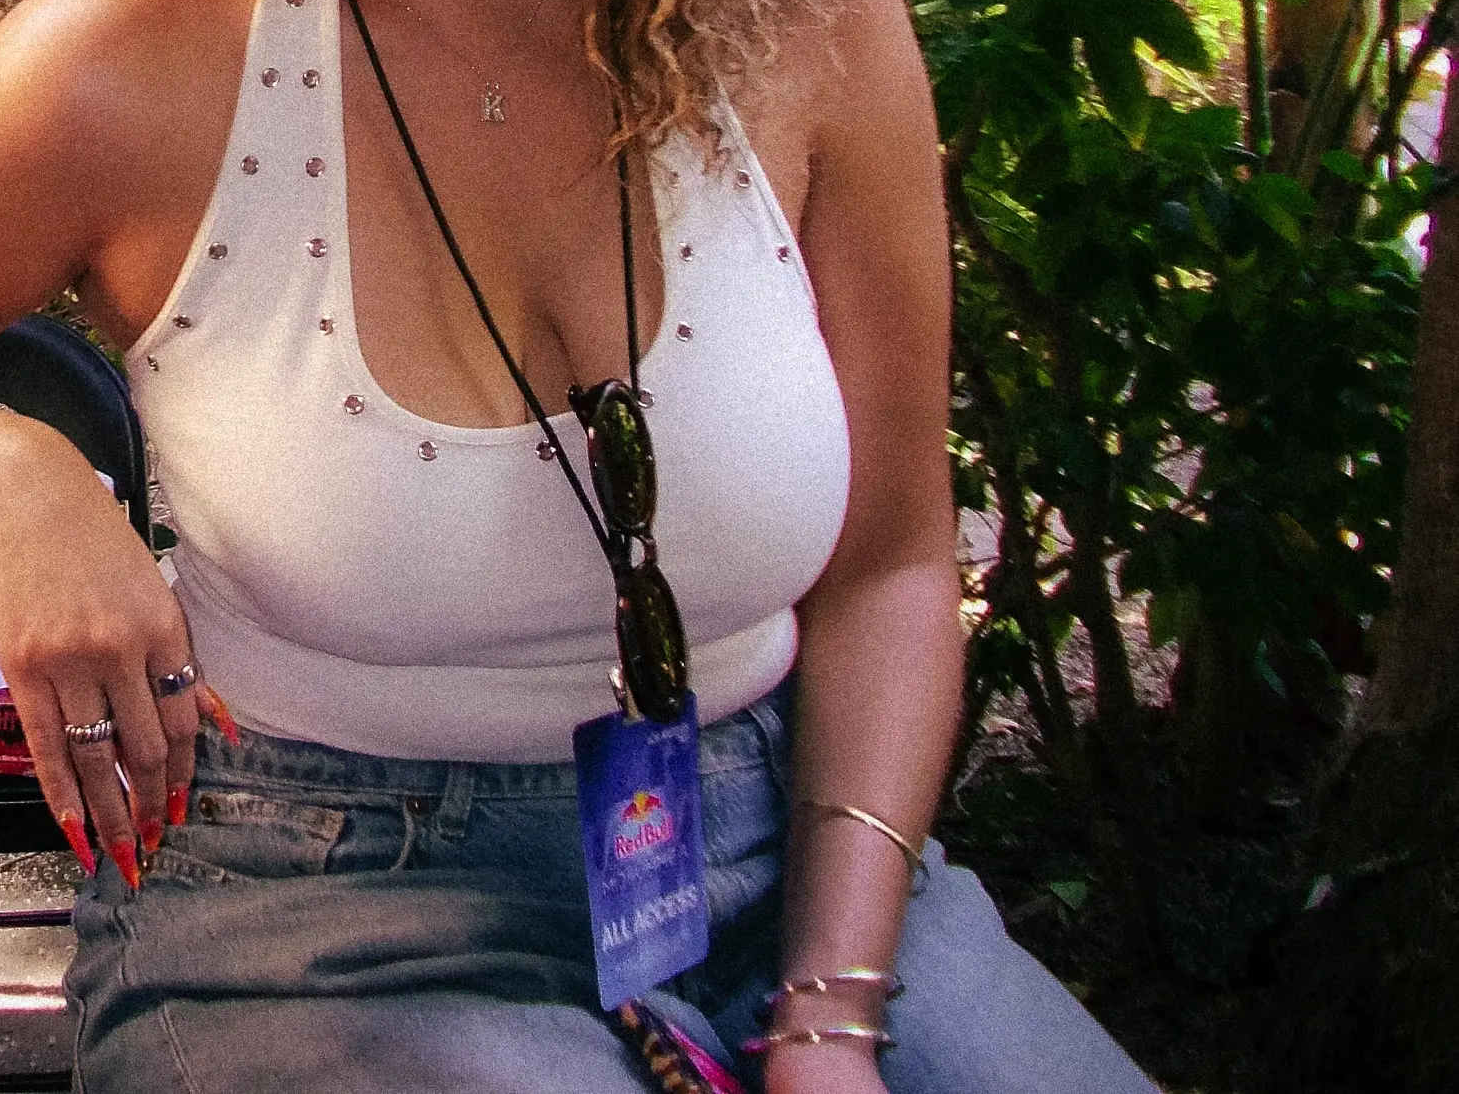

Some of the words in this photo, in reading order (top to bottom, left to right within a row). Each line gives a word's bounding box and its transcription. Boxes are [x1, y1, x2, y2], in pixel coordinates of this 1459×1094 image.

[614, 832, 641, 860] Red
[640, 813, 675, 847] Bull
[601, 915, 631, 952] ALL
